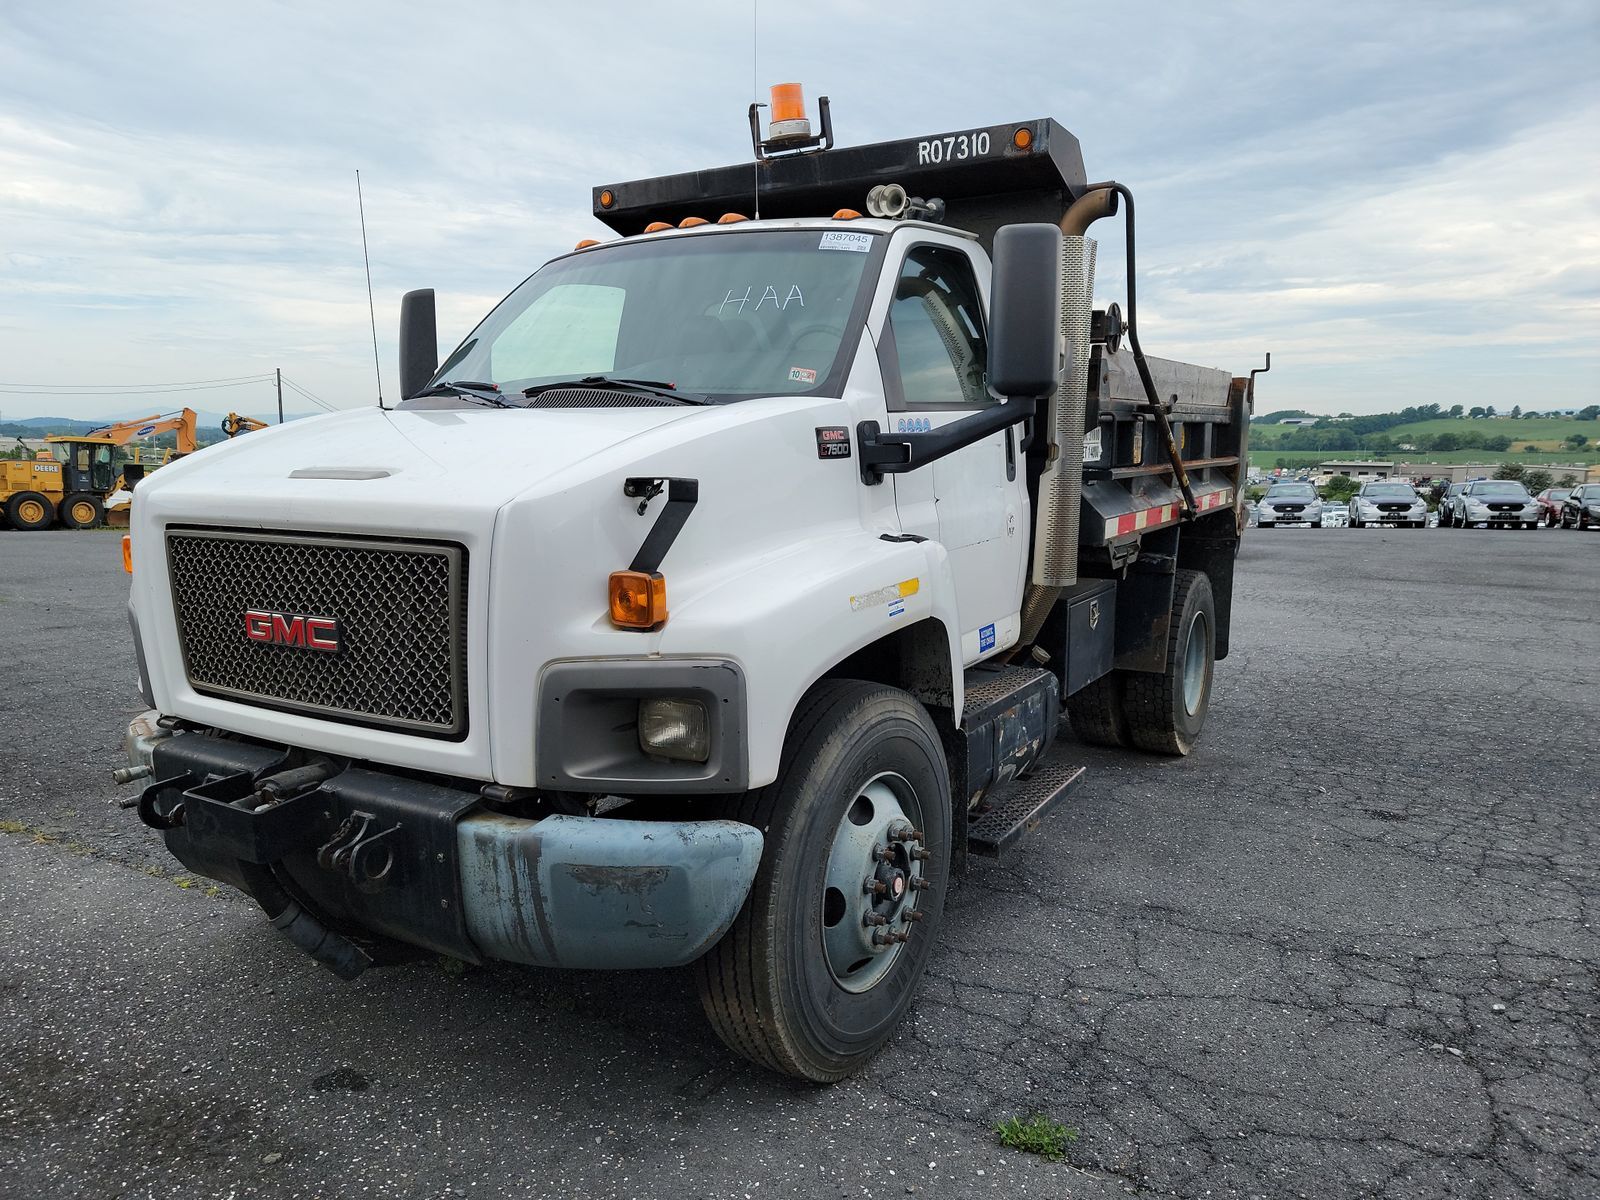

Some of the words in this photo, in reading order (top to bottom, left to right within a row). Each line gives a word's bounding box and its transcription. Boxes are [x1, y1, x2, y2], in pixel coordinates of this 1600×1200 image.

[824, 233, 869, 243] 1387045
[719, 284, 804, 314] HAA
[792, 370, 800, 379] 10
[822, 430, 845, 440] GMC
[34, 464, 59, 473] DEERE
[245, 610, 338, 650] GMC
